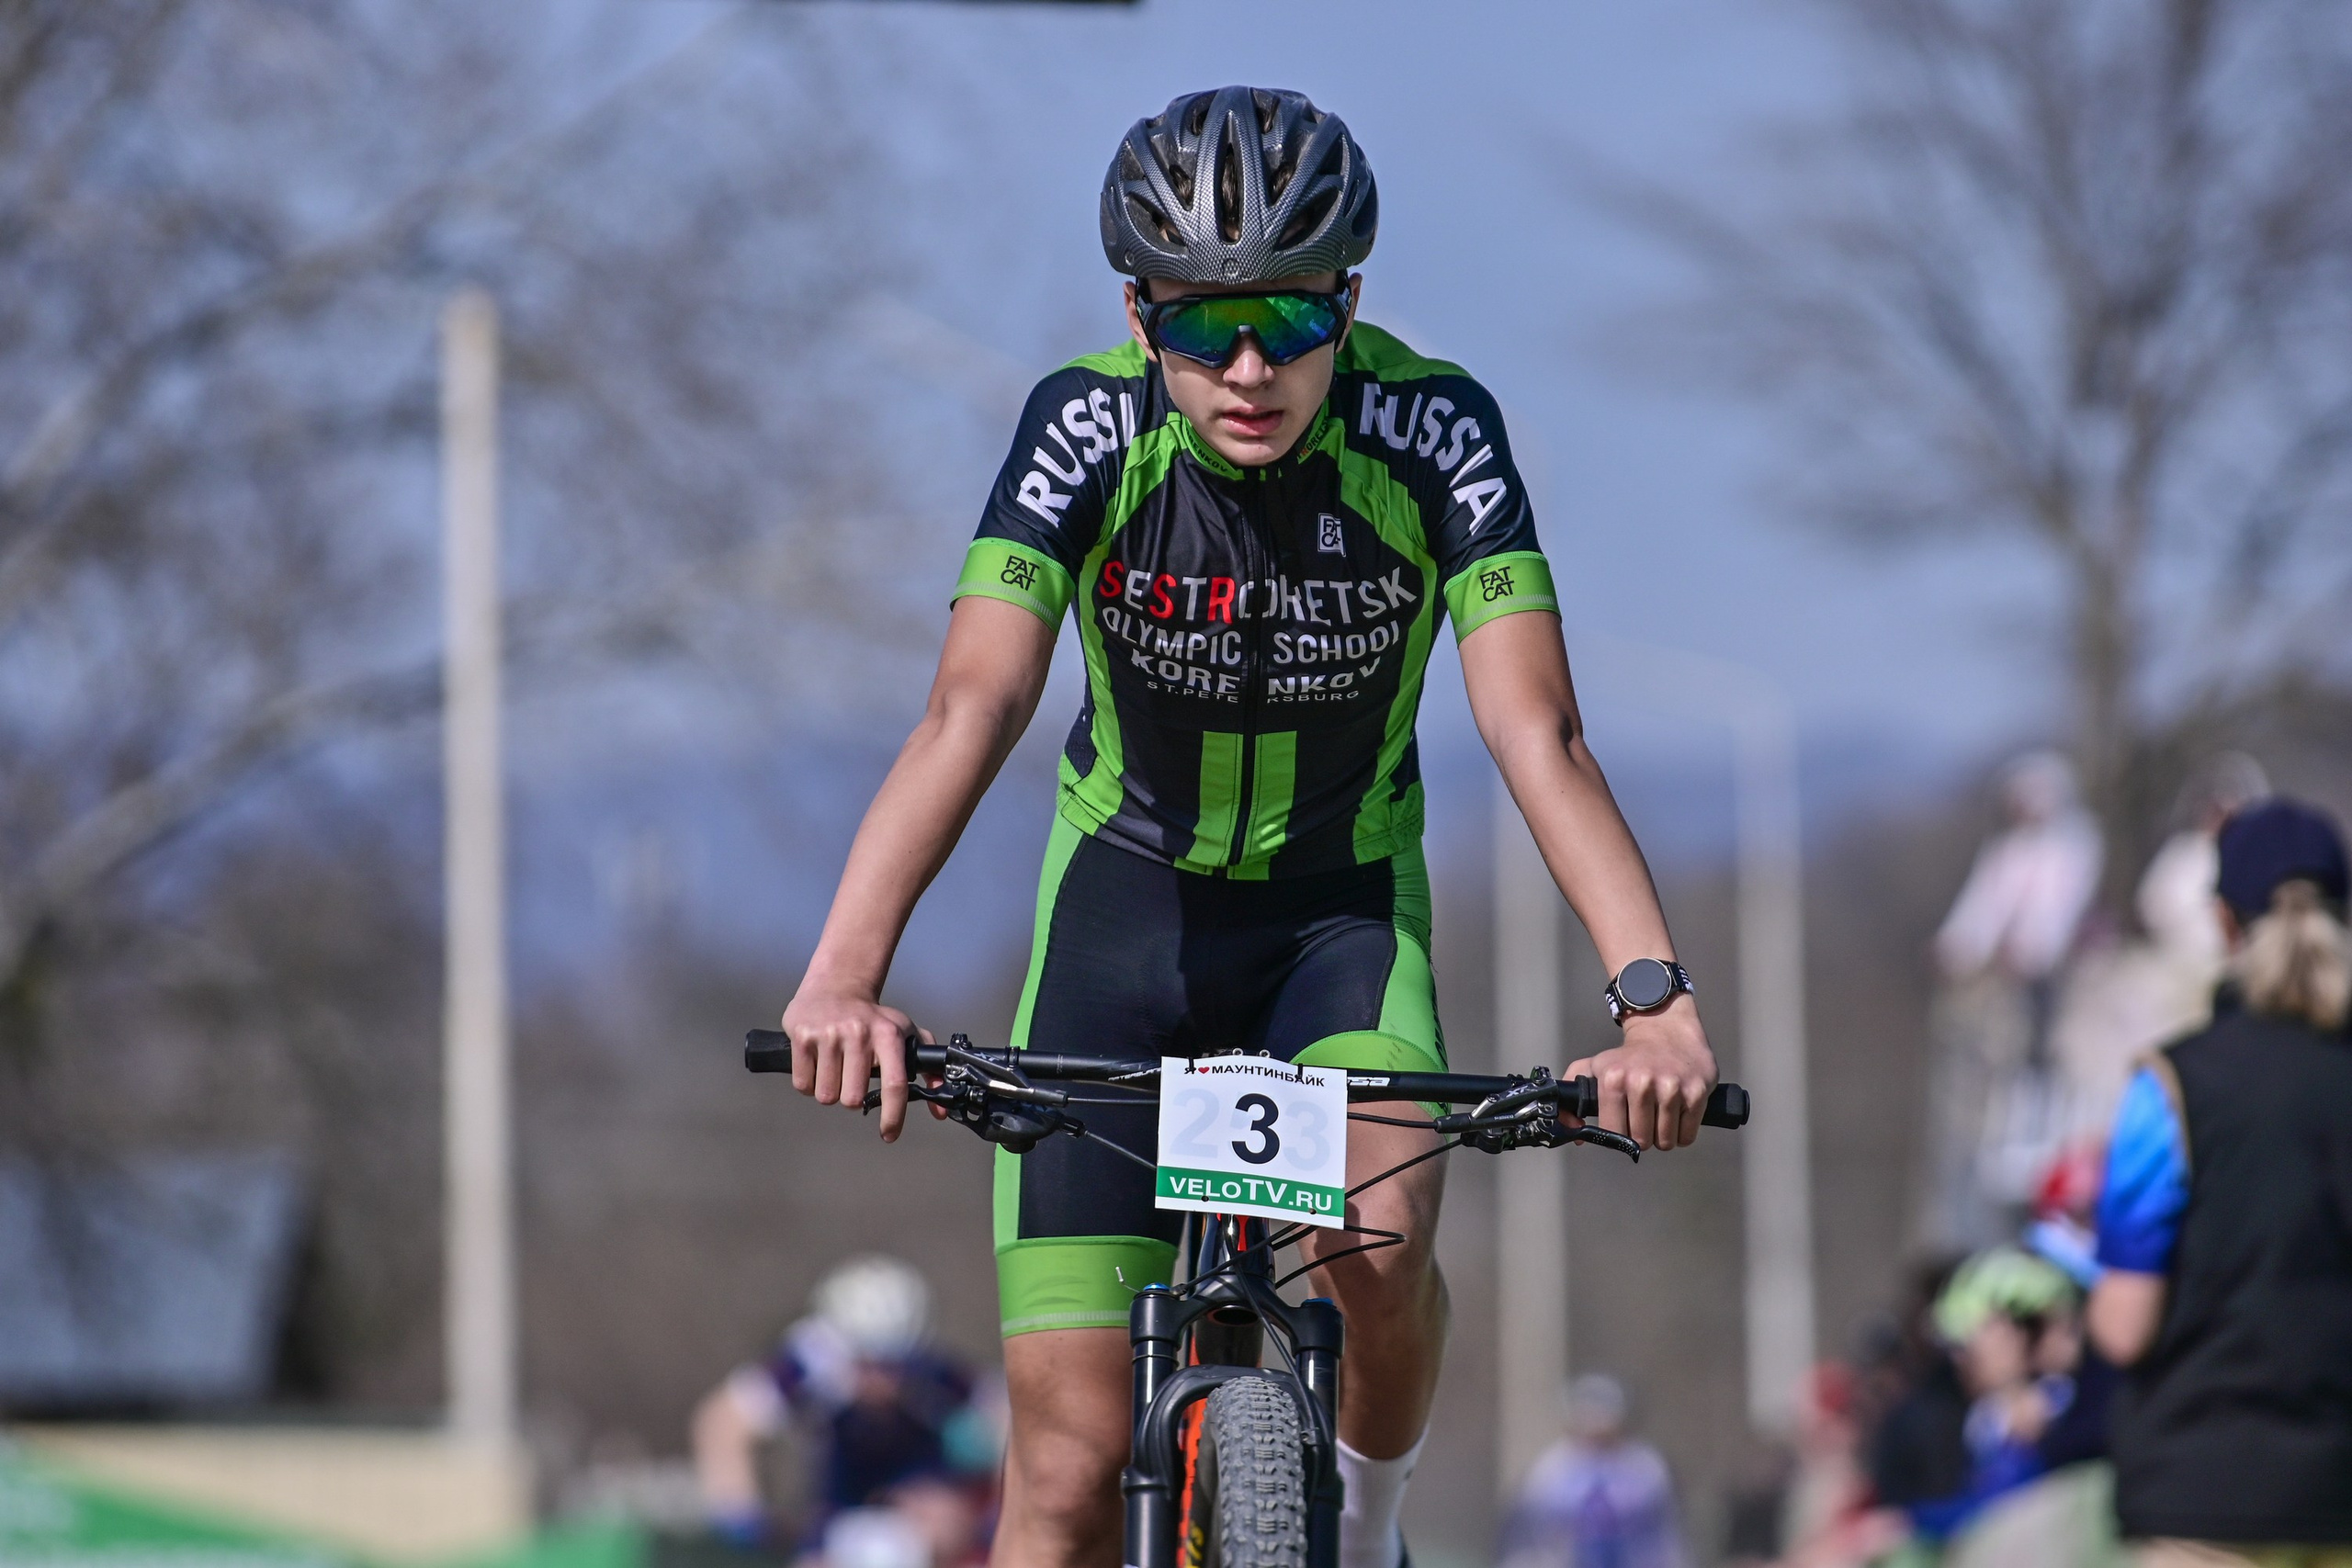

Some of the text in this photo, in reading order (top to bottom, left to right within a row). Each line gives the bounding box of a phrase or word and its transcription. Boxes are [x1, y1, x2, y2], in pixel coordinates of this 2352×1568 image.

[1016, 388, 1136, 529] RUSSI
[1359, 382, 1507, 536] RUSSIA
[1001, 569, 1035, 591] CAT
[1005, 555, 1040, 578] FAT
[1479, 566, 1510, 590] FAT
[1483, 580, 1515, 602] CAT
[1102, 606, 1241, 665] OLYMPIC
[1212, 1065, 1326, 1088] МАУНТИНБАЙК
[1231, 1093, 1281, 1165] 3
[1170, 1177, 1332, 1212] VELOTV.RU
